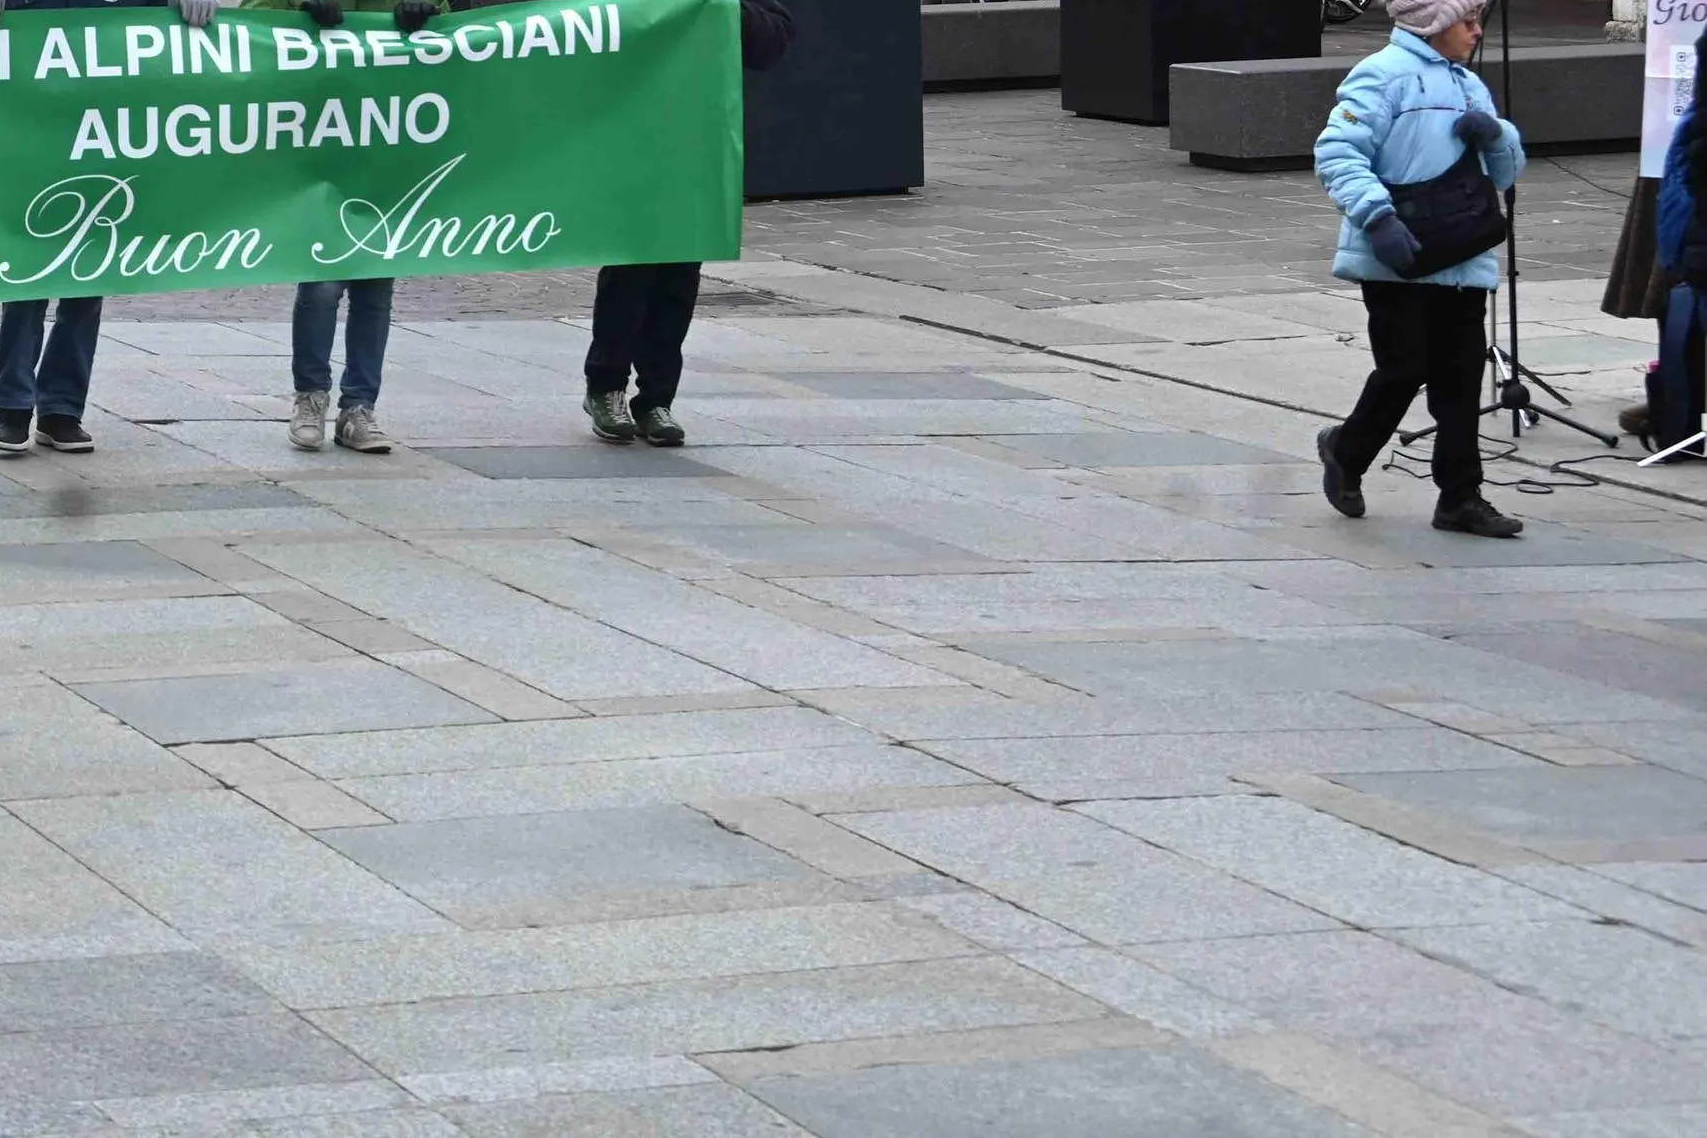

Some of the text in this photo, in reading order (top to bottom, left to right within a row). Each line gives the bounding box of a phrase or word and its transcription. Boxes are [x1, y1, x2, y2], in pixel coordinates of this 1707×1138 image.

[34, 22, 253, 80] ALPINI
[271, 2, 621, 72] BRESCIANI
[69, 92, 451, 160] AUGURANO
[310, 153, 562, 264] Anno
